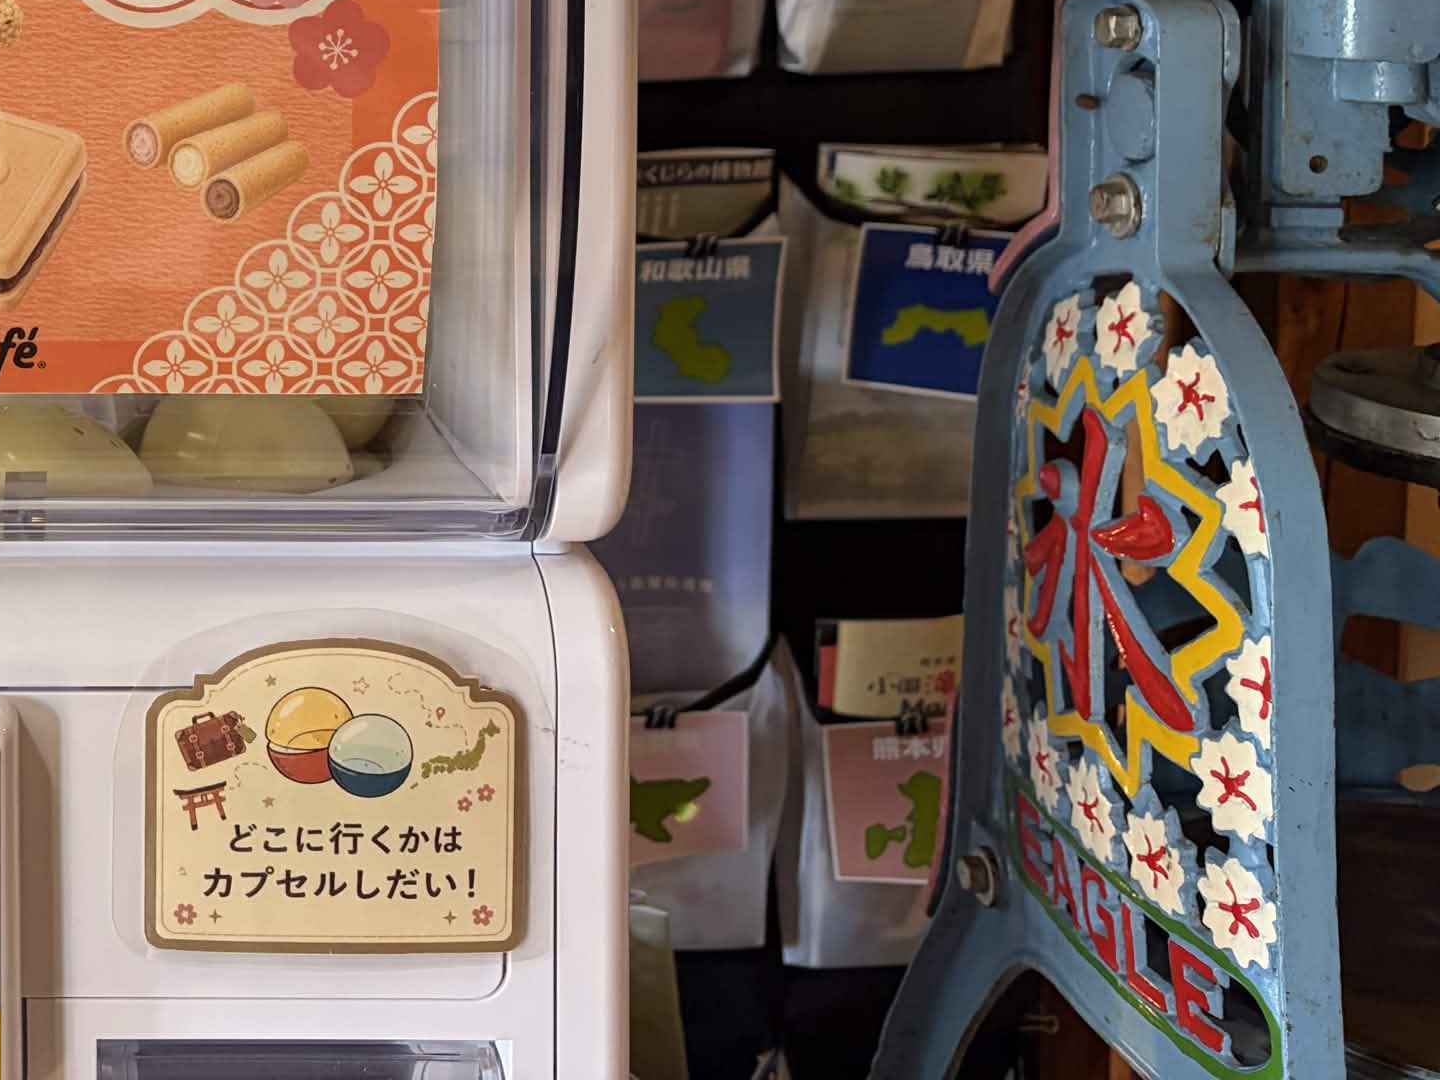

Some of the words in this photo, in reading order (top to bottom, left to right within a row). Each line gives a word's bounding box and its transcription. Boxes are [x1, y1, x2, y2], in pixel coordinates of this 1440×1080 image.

[639, 254, 752, 283] 和歌山県
[905, 242, 995, 276] 鳥取県
[1023, 407, 1196, 733] 氷
[228, 821, 463, 856] どこに行くかは
[202, 865, 478, 900] カプセルしだい！
[1016, 790, 1225, 1053] EAGLE
